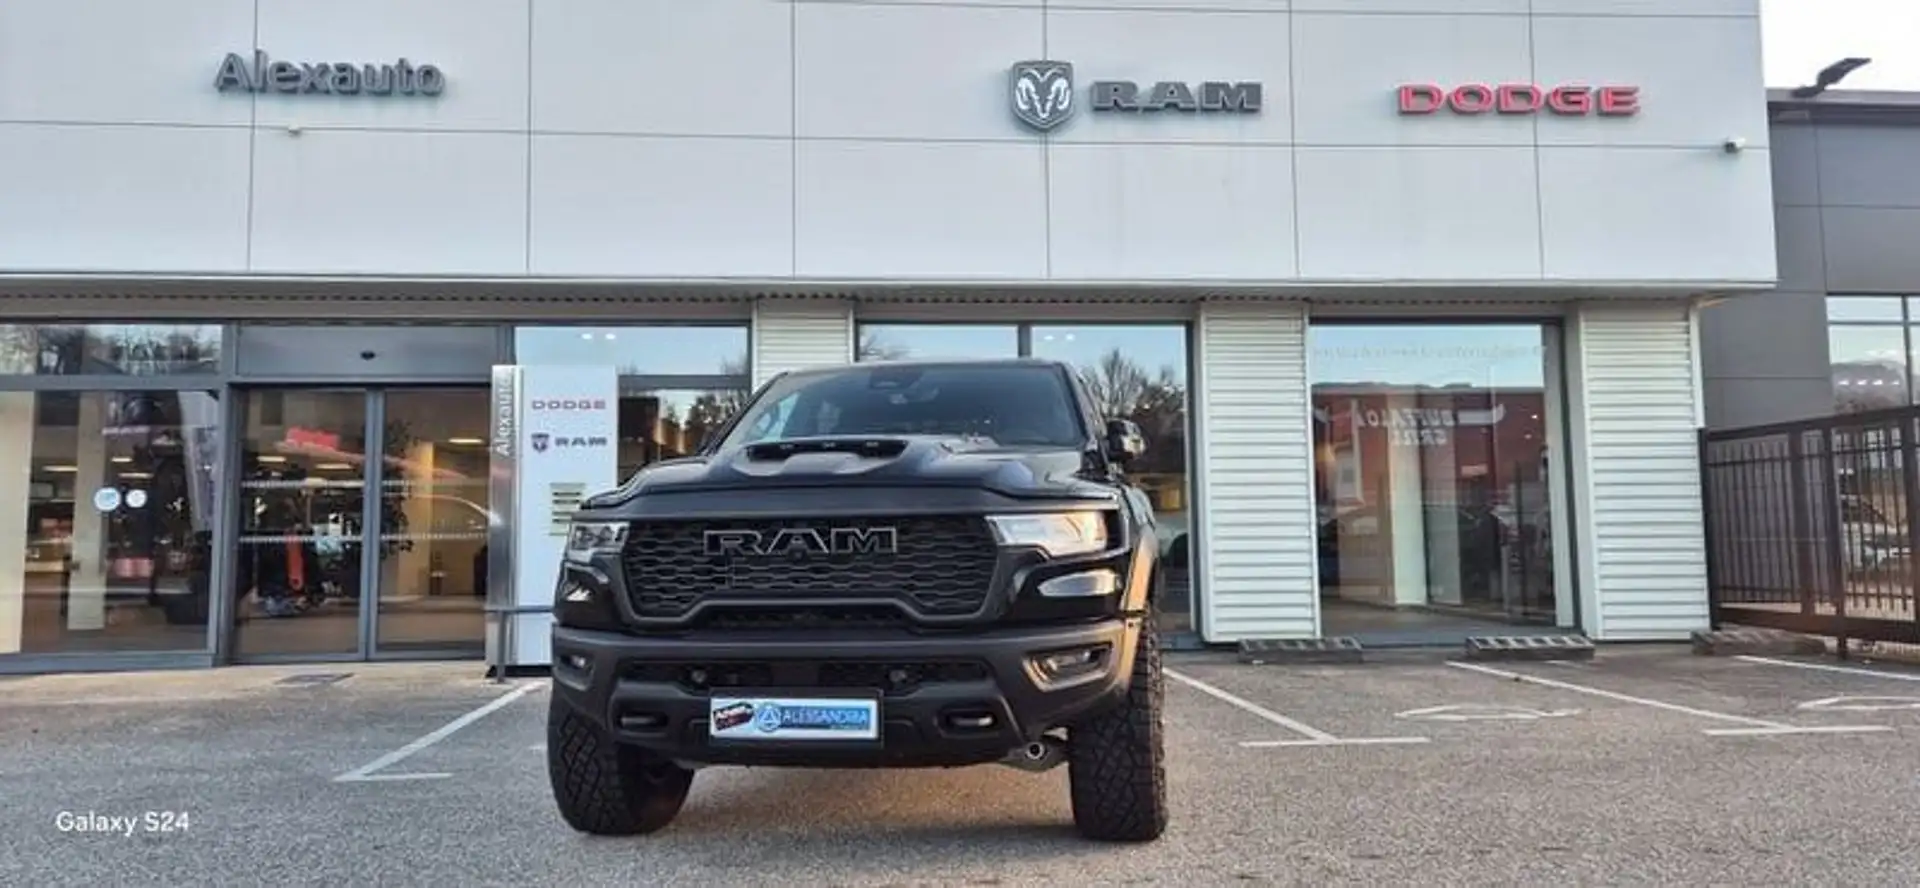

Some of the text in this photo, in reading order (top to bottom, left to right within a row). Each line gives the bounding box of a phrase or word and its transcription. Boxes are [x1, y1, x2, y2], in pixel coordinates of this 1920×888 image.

[213, 48, 444, 97] Alexauto
[1092, 80, 1262, 113] RAM
[1397, 83, 1641, 116] DODGE
[532, 400, 605, 410] DODGE
[555, 437, 607, 447] RAM
[703, 527, 897, 555] RAM
